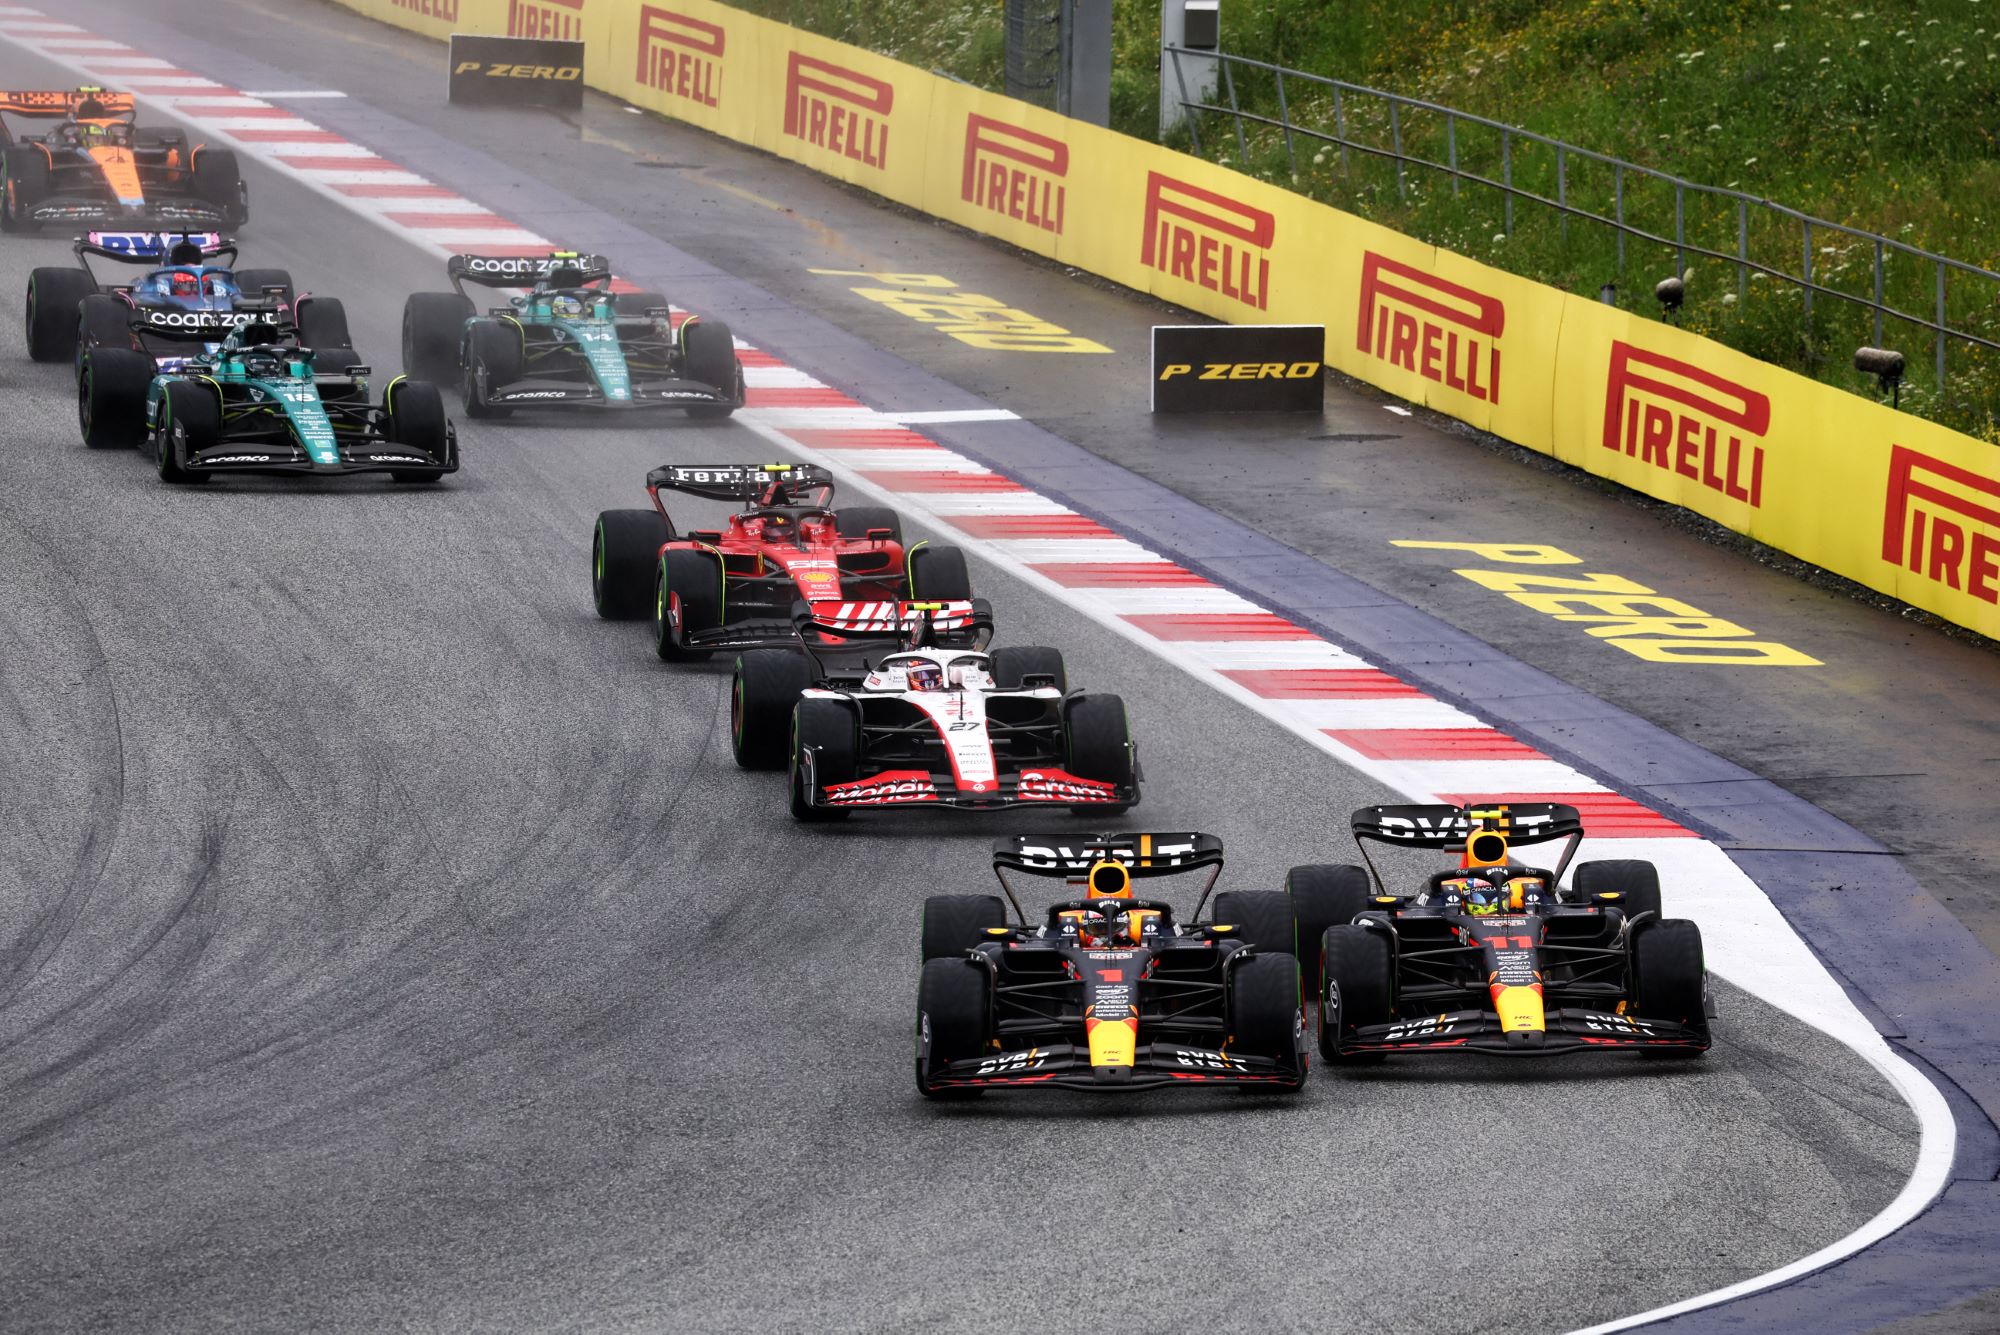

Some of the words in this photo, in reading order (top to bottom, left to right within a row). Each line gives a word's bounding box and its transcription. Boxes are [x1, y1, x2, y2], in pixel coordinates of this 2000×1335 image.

[636, 4, 725, 108] PIRELLI
[455, 62, 480, 75] P
[486, 64, 582, 80] ZERO
[783, 50, 893, 170] PIRELLI
[961, 112, 1069, 235] PIRELLI
[1140, 170, 1275, 312] PIRELLI
[582, 333, 613, 342] 14
[1356, 250, 1505, 405] PIRELLI
[1159, 364, 1191, 381] P
[1198, 361, 1321, 381] ZERO
[283, 393, 316, 402] 18
[1602, 339, 1770, 509] PIRELLI
[205, 454, 270, 463] aramco
[1452, 568, 1825, 666] ZERO
[948, 722, 981, 732] 27
[1482, 935, 1533, 948] 11
[1096, 969, 1123, 982] 1
